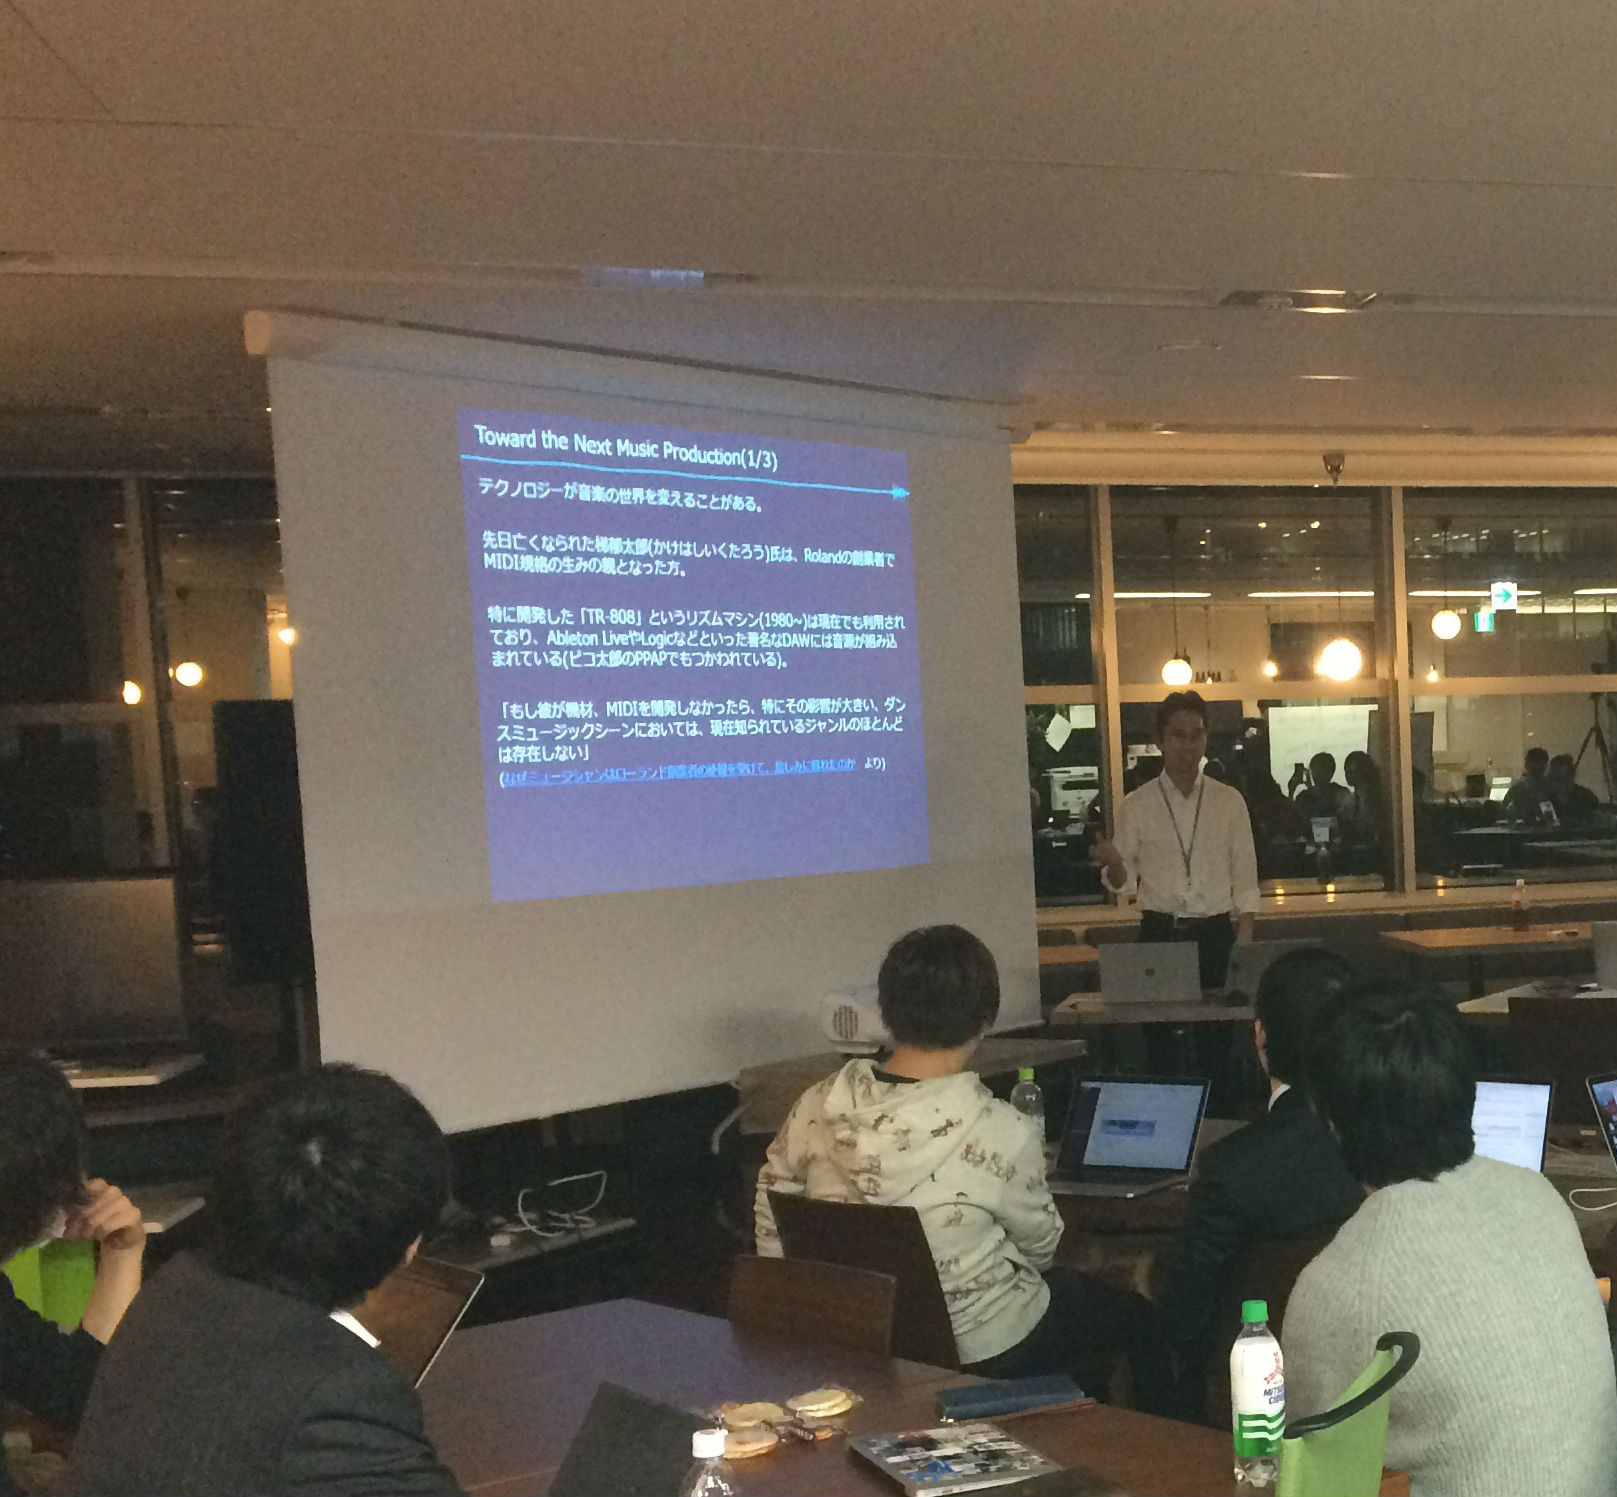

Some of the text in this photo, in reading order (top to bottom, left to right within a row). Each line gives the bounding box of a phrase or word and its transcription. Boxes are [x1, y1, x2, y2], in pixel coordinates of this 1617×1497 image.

[473, 424, 778, 473] Toward the Next Music Production(1/3)
[478, 477, 762, 513] テクノロジーが音楽の世界を変えることがある。
